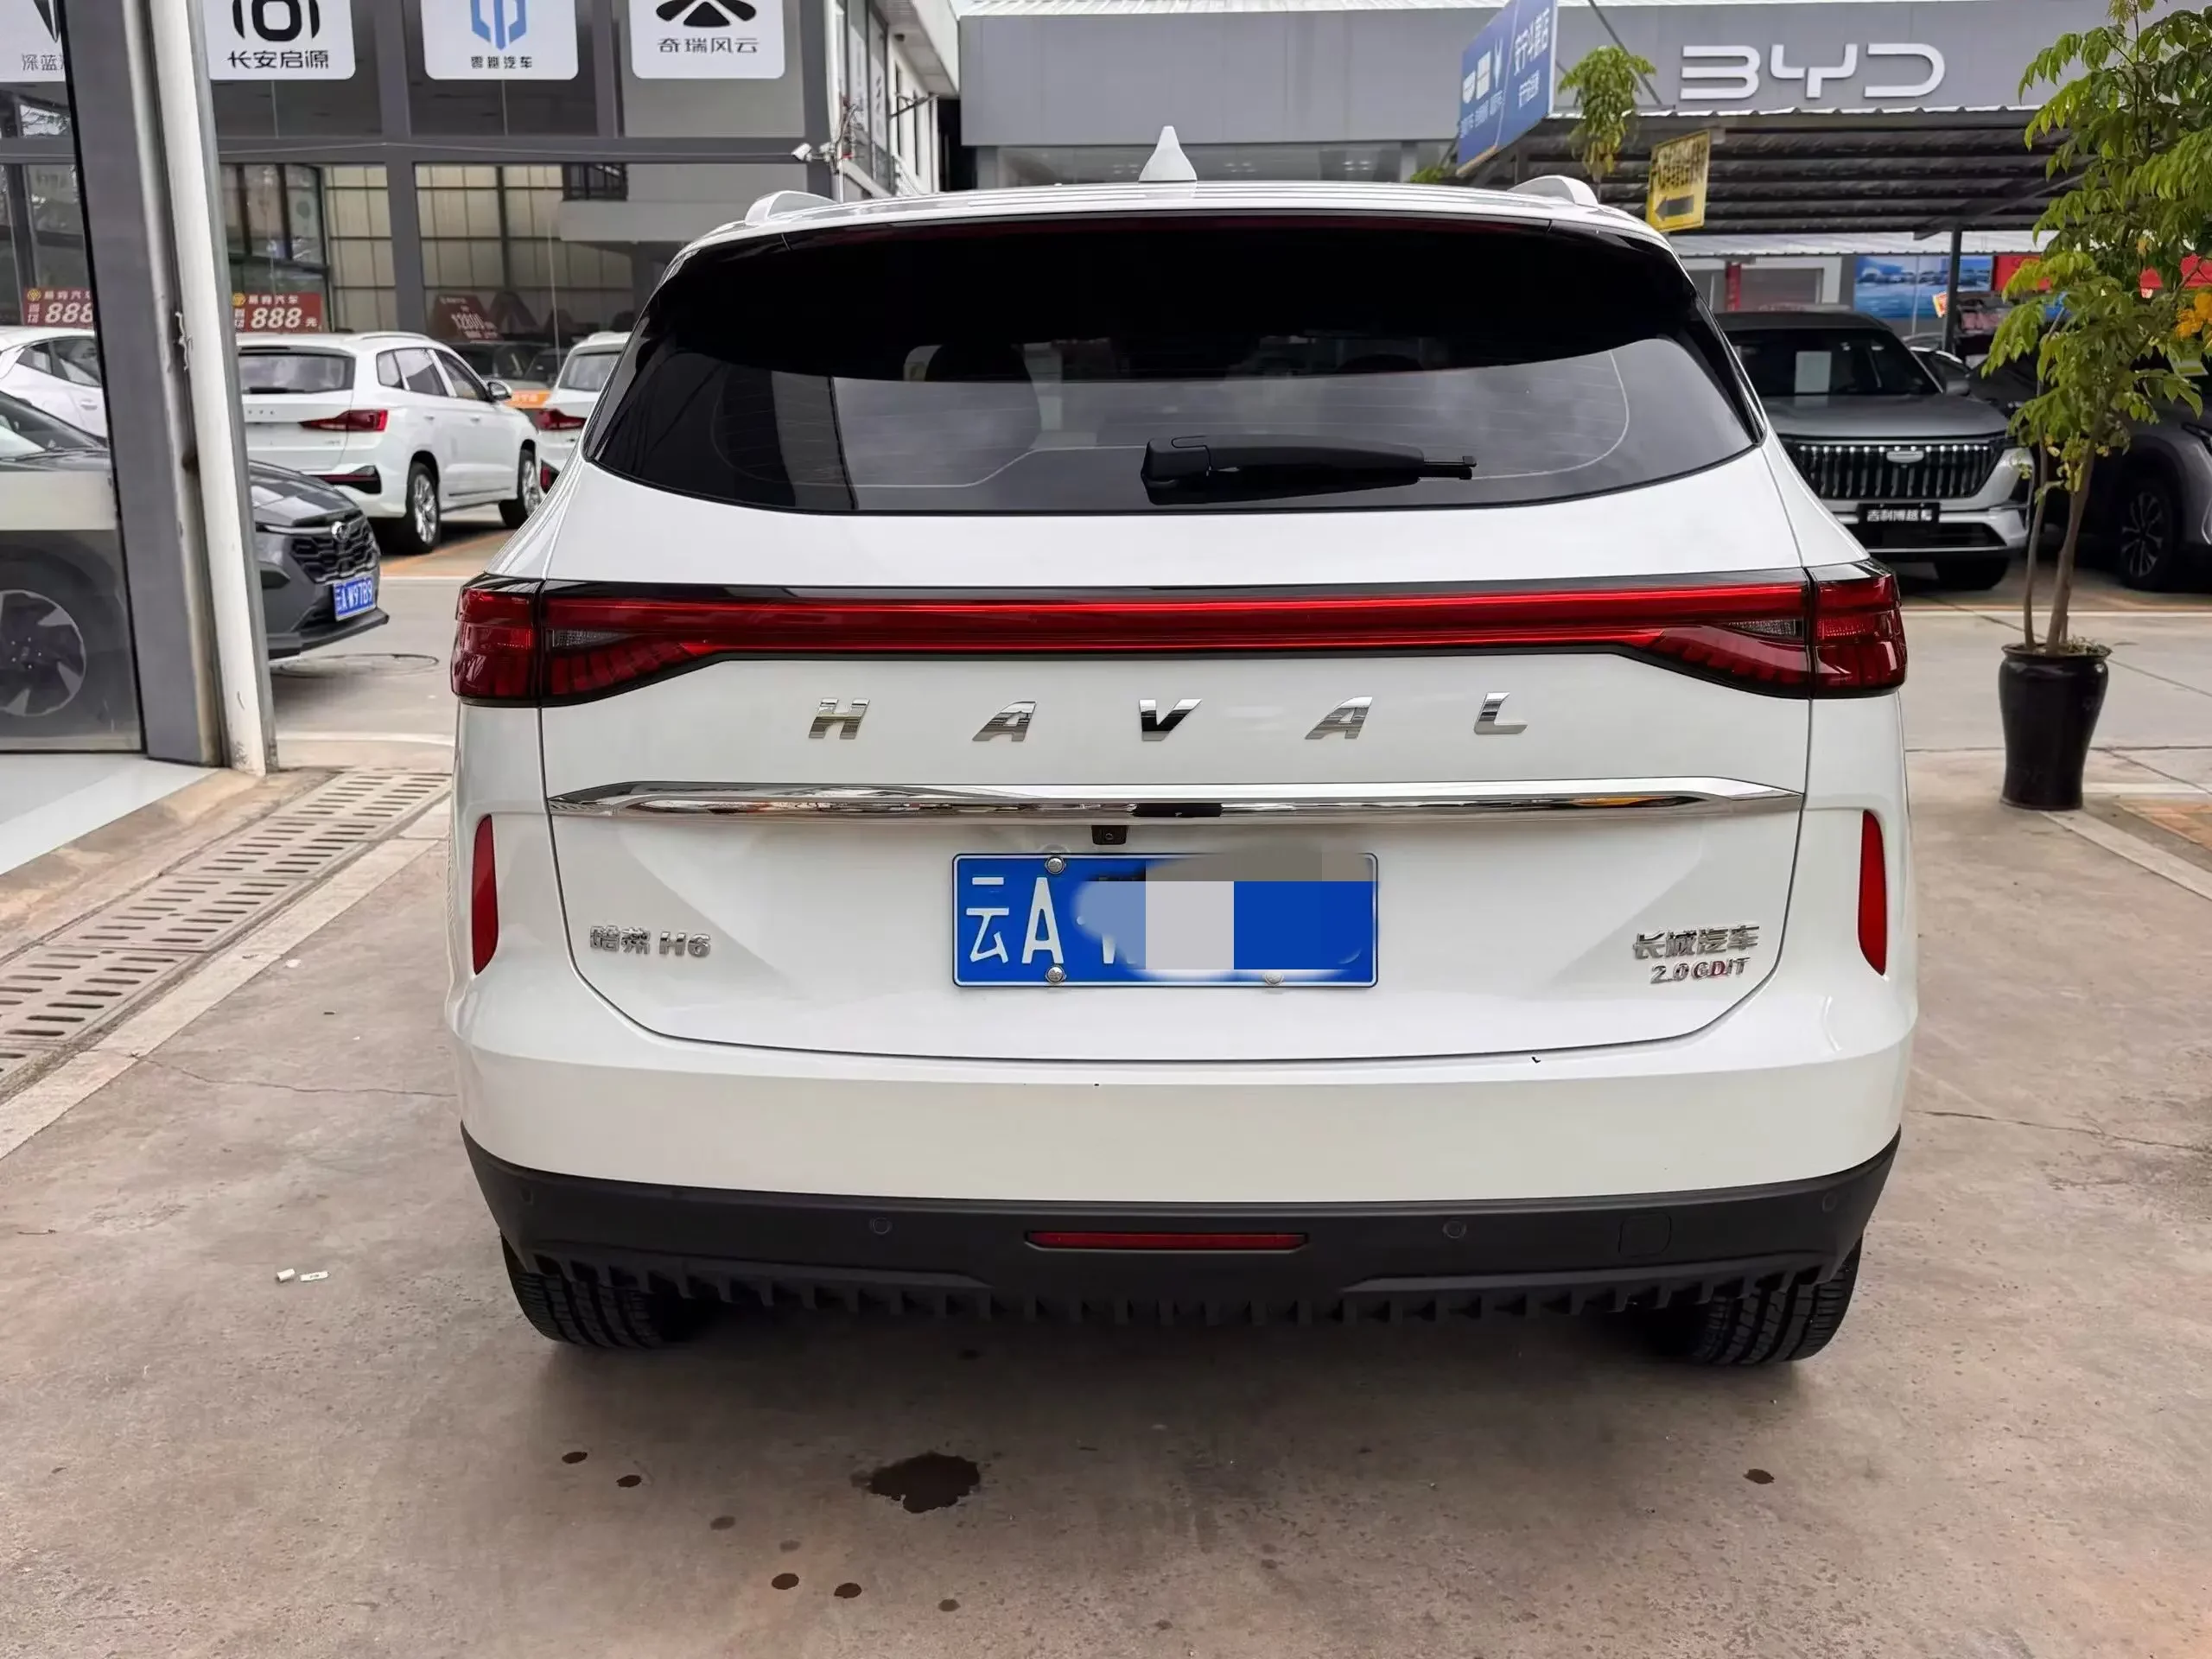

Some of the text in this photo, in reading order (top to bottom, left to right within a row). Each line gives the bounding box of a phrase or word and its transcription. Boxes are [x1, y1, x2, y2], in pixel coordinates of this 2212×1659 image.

[658, 37, 759, 53] 奇瑞风云
[227, 50, 329, 69] 长安启源
[1679, 43, 1946, 100] BYD
[251, 307, 302, 328] 888
[808, 692, 1529, 741] HAVAL
[658, 931, 712, 957] H6
[1633, 925, 1760, 959] 长城汽车
